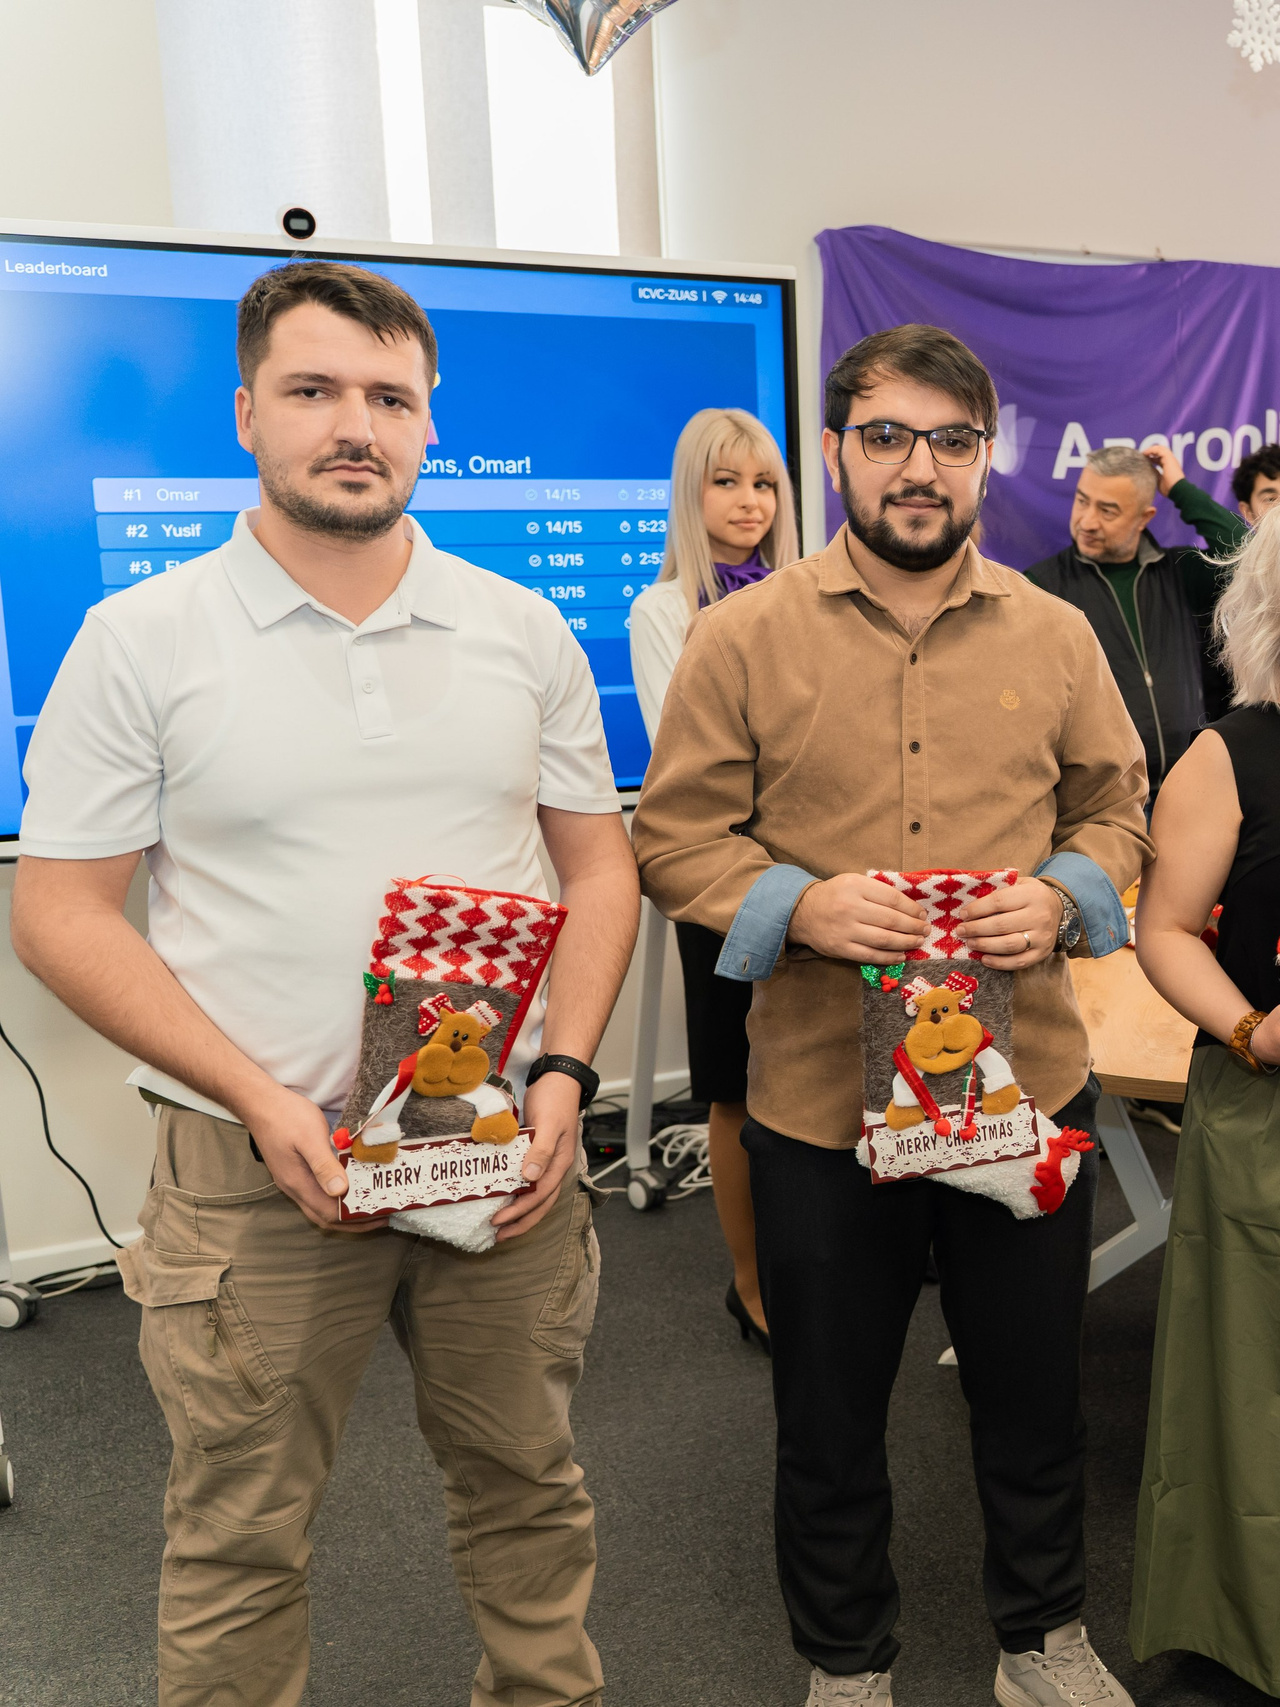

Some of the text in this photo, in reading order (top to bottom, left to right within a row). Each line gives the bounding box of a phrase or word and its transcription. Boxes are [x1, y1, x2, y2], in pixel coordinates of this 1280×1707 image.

[5, 259, 108, 277] Leaderboard
[638, 287, 699, 302] ICVC-ZUAS
[733, 292, 763, 305] 14:48
[468, 455, 531, 474] Omar!
[123, 488, 666, 502] #1 Omar 14/15 2:39
[125, 519, 667, 538] #2 Yusif 14/15 5:23
[129, 560, 153, 575] #3
[547, 553, 585, 568] 13/15
[549, 585, 586, 600] 13/15
[896, 1120, 1014, 1157] MERRY CHSTMAS
[372, 1153, 509, 1190] MERRY CHRISTMAS
